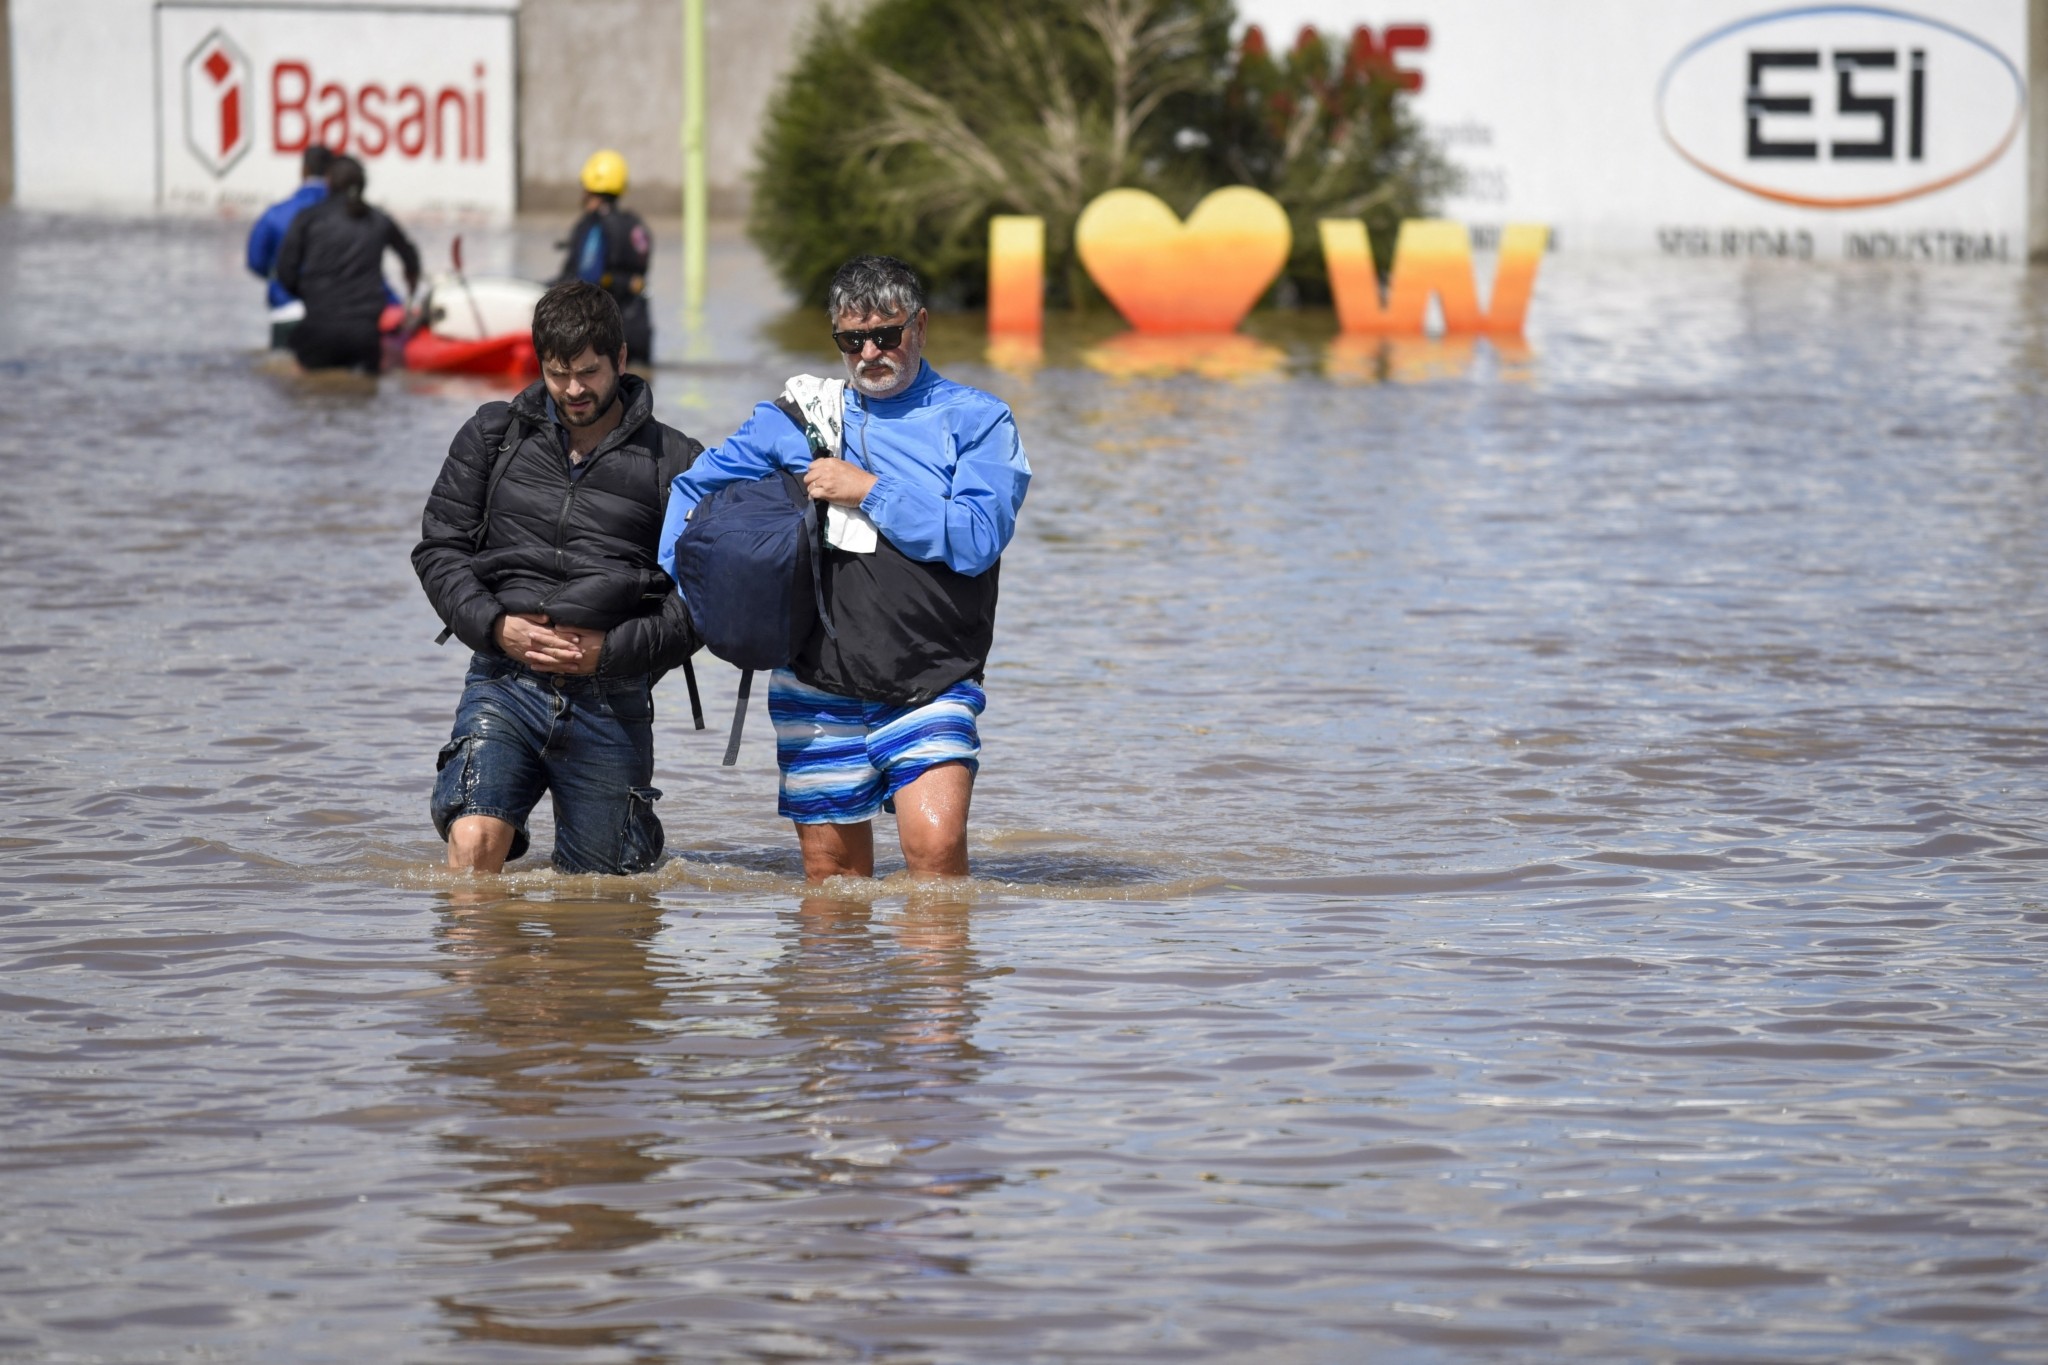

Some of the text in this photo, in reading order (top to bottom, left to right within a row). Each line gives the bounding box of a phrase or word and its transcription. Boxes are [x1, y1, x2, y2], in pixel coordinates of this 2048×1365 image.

[272, 60, 489, 162] Basani
[989, 215, 1549, 334] I W
